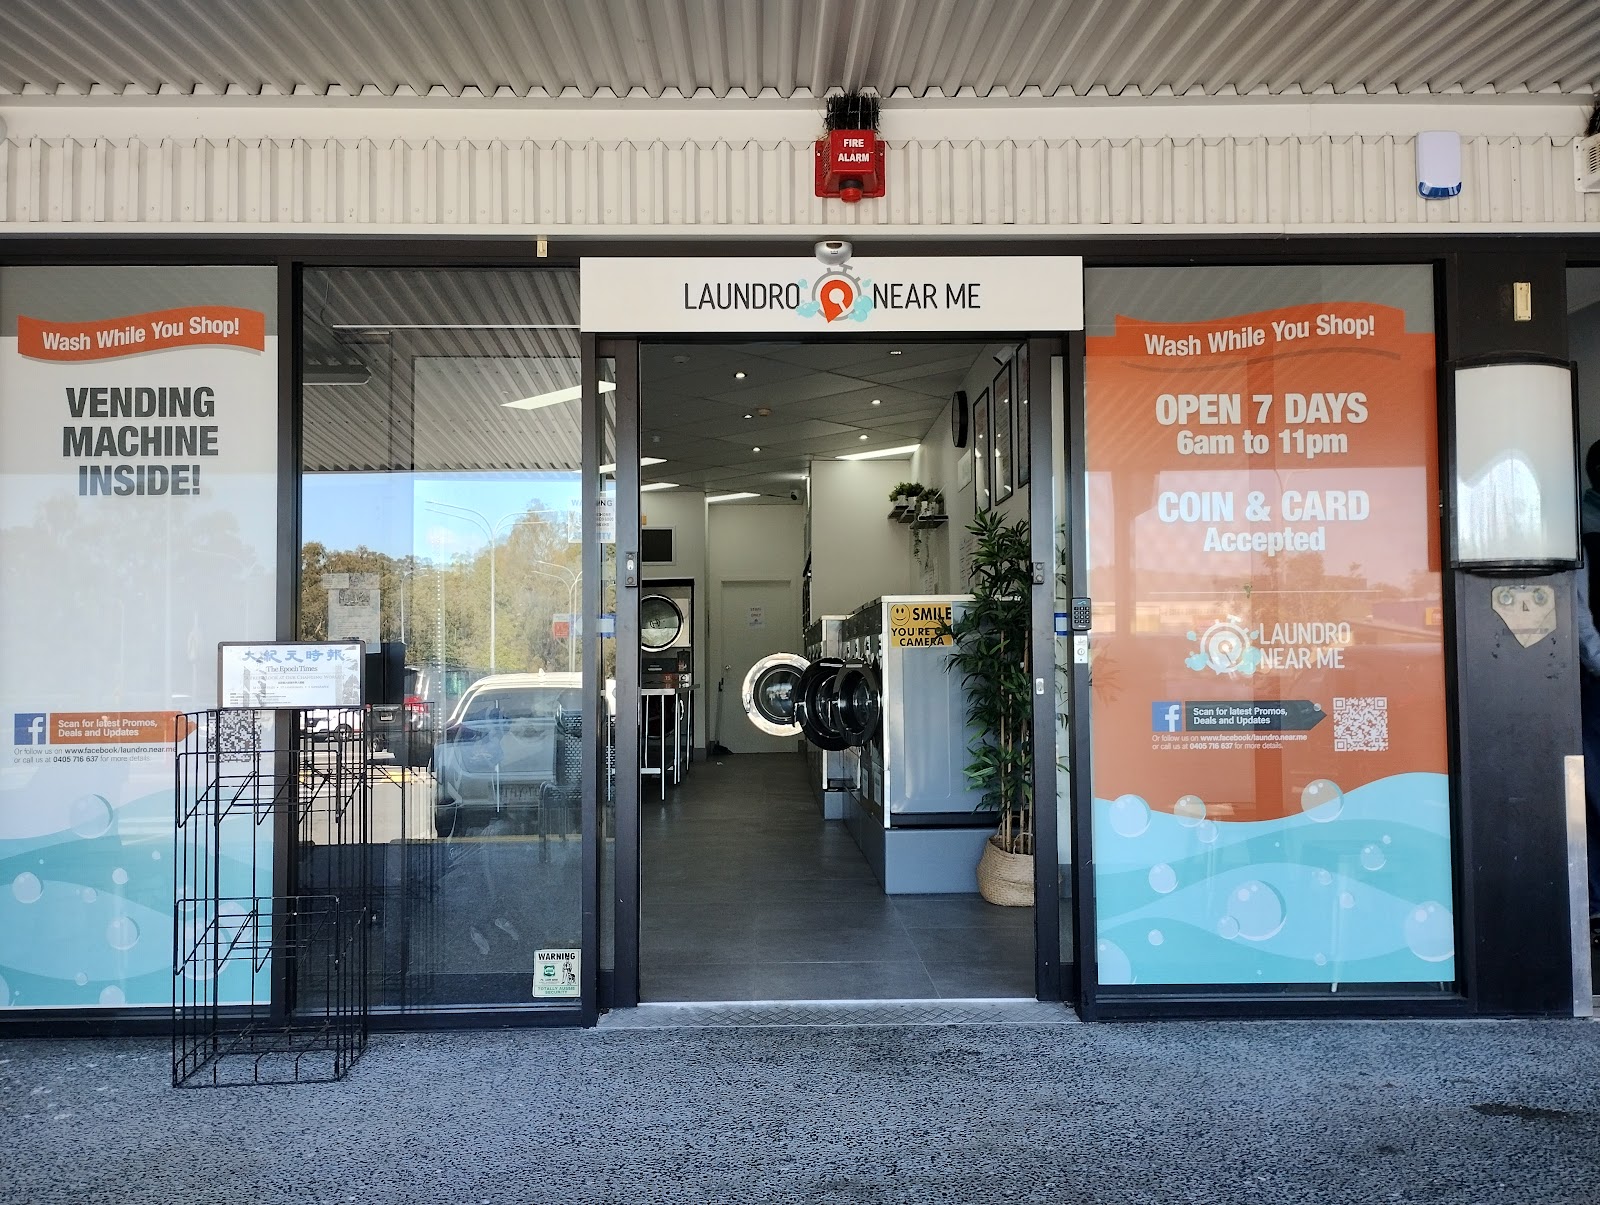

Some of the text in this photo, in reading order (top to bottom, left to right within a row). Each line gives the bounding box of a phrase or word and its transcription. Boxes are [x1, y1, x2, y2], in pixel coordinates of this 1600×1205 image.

[843, 139, 865, 148] FIRE
[837, 153, 870, 162] ALARM
[683, 282, 981, 310] LAUNDRO NEAR ME
[42, 316, 239, 351] Wash While You Shop!
[1144, 314, 1375, 356] Wash While You Shop!
[65, 386, 215, 418] VENDING
[1155, 392, 1368, 425] OPEN 7 DAYS
[62, 425, 219, 457] MACHINE
[1176, 428, 1348, 459] 6am to 11pm
[78, 464, 201, 496] INSIDE!
[1158, 490, 1370, 523] COIN & CARD
[1203, 527, 1326, 557] Accepted
[912, 607, 952, 620] SMILE
[891, 627, 930, 636] YOU'RE
[1259, 622, 1351, 645] LAUNDRO
[899, 637, 945, 647] CAMERA
[241, 649, 346, 664] 大紀元時報
[1259, 647, 1346, 669] NEAR ME
[279, 665, 299, 673] Epoch
[299, 665, 319, 673] Times
[1193, 706, 1288, 717] Scan for latest Promos,
[58, 718, 158, 728] Scan for latest Promos,
[1193, 716, 1271, 726] Deals and Updates
[58, 728, 139, 738] Deals and Updates
[1161, 734, 1180, 742] follow
[1200, 734, 1308, 742] www.facebook/laundro.near.me
[23, 747, 43, 755] follow
[1189, 742, 1209, 750] 0405
[538, 952, 576, 961] WARNING
